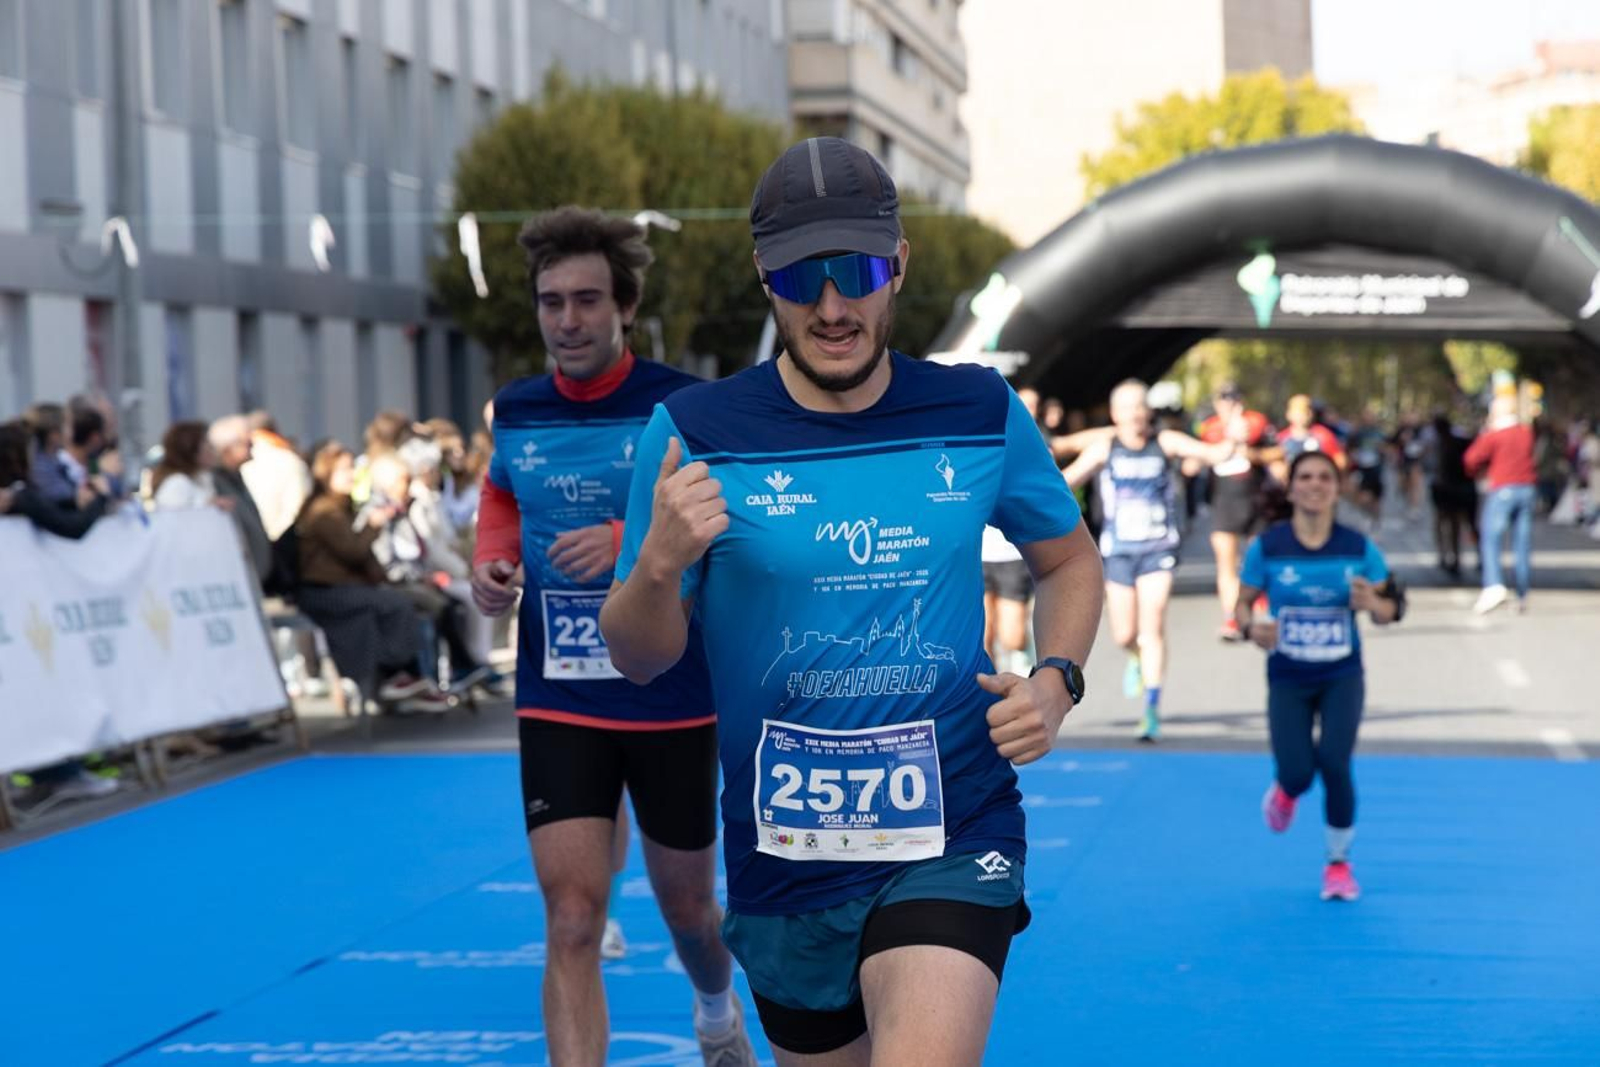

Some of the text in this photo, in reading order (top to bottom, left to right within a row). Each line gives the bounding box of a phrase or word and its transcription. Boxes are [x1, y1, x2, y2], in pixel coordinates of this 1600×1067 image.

[777, 493, 817, 503] RURAL
[878, 525, 914, 538] MEDIA
[876, 537, 930, 551] MARATÓN
[872, 552, 901, 565] JAÉN
[554, 615, 608, 646] 22
[787, 664, 938, 699] #DEJAHUELLA
[820, 740, 840, 748] MEDIA
[841, 738, 872, 747] MARATÓN
[825, 747, 833, 755] EN
[836, 747, 865, 756] MEMORIA
[770, 763, 927, 812] 2570
[818, 813, 879, 824] JOSE JUAN
